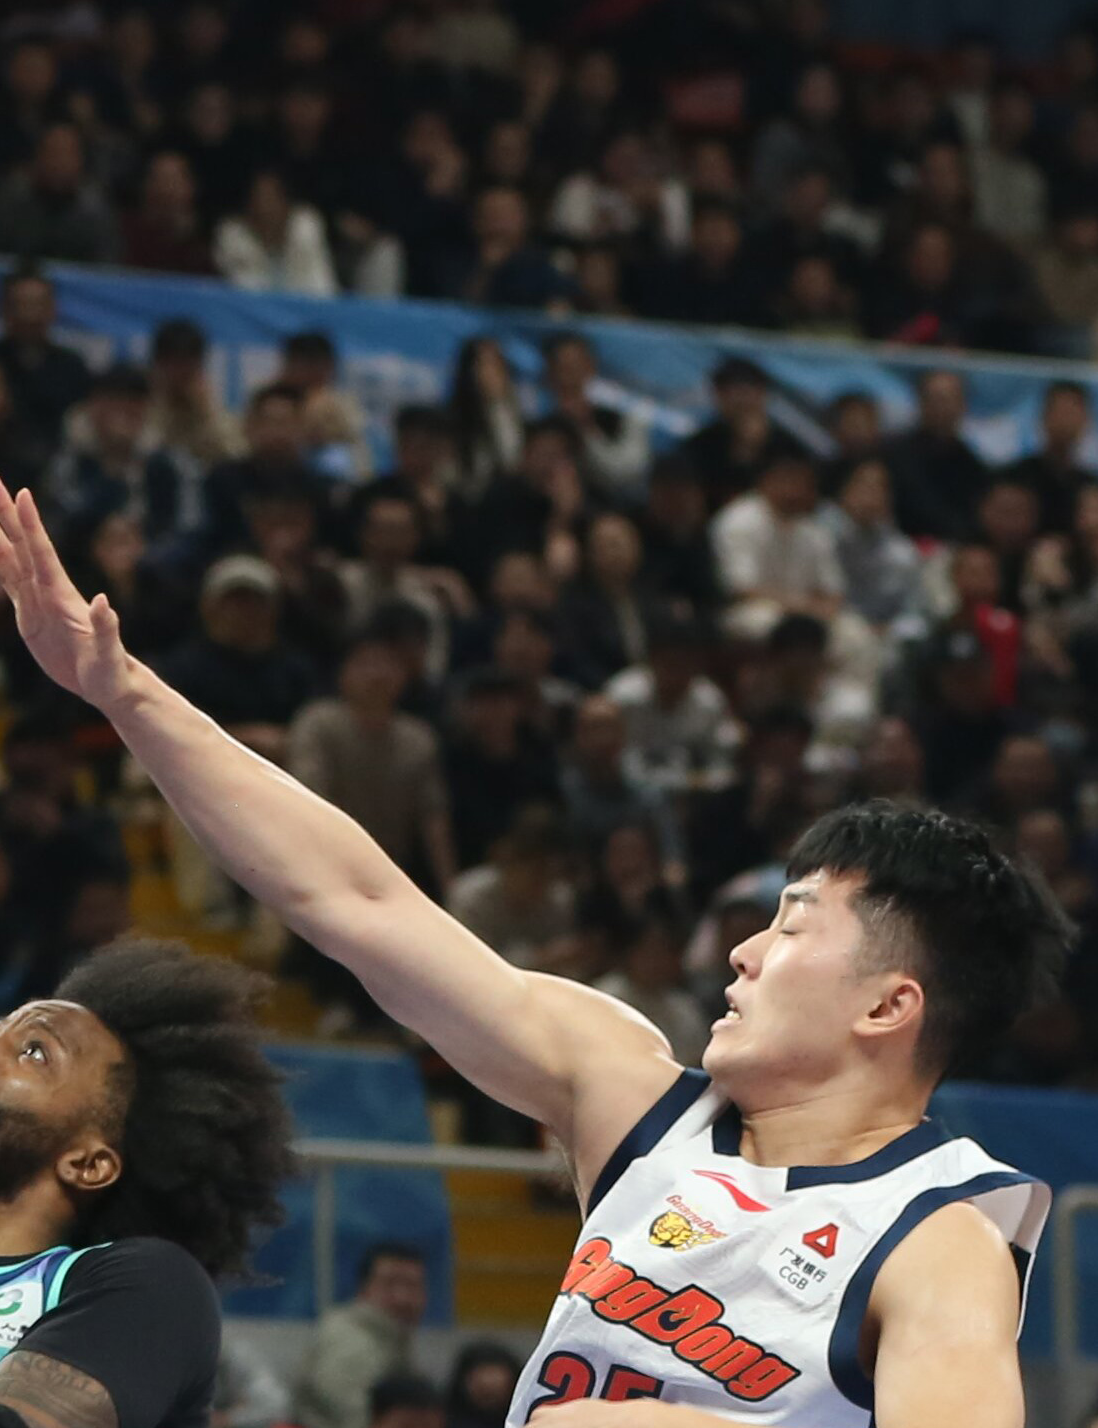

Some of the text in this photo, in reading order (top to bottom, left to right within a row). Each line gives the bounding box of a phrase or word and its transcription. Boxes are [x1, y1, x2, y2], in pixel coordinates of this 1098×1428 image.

[779, 1247, 828, 1283] 广发银行
[779, 1266, 809, 1291] CGB
